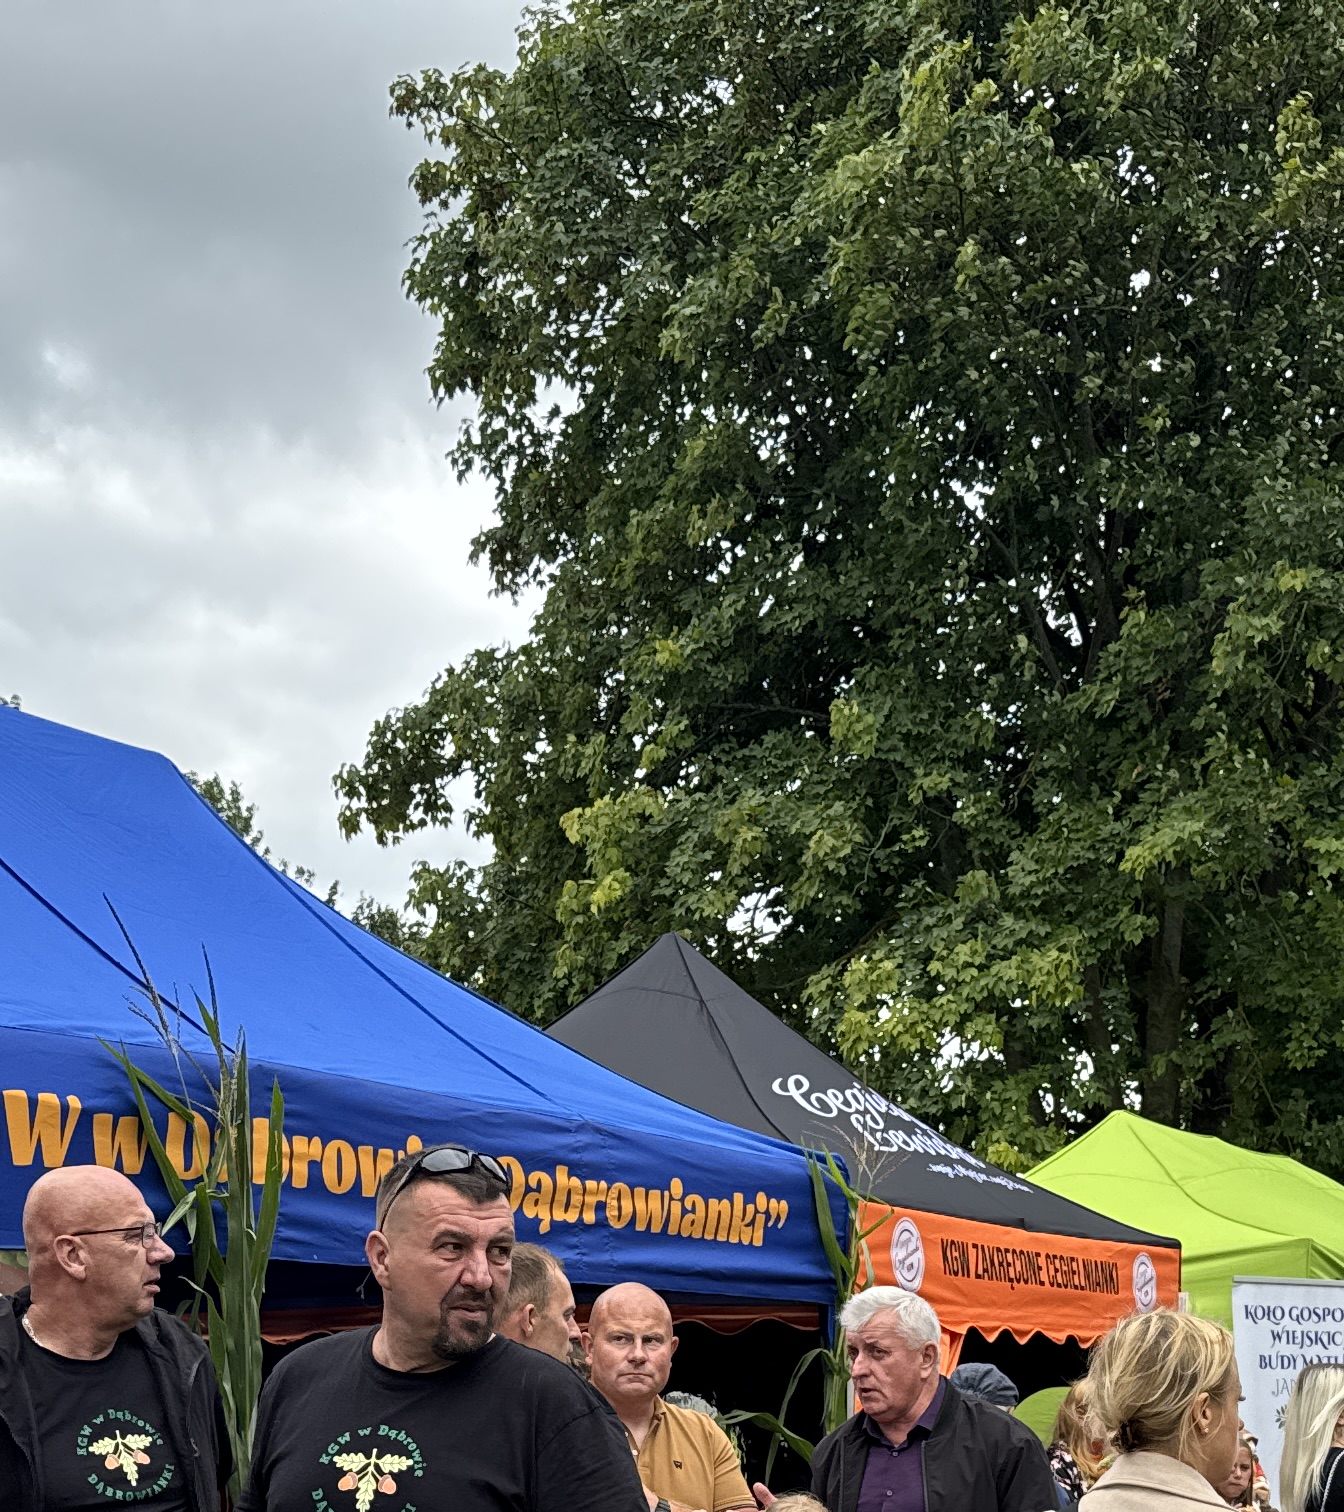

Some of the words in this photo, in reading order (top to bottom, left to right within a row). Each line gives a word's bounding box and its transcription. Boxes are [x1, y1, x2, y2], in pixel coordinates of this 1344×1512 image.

[92, 1112, 148, 1175] w
[166, 1111, 423, 1198] Dbrow
[940, 1238, 971, 1279] KGW
[972, 1242, 1045, 1290] ZAKRĘCONE
[1045, 1253, 1119, 1295] CEGIELNIANKI
[1244, 1304, 1285, 1325] KOŁO
[1259, 1350, 1299, 1370] BUDY
[76, 1424, 93, 1456] KGW
[319, 1431, 351, 1465] KGW
[357, 1426, 373, 1437] w
[377, 1424, 427, 1478] Dąbrowie
